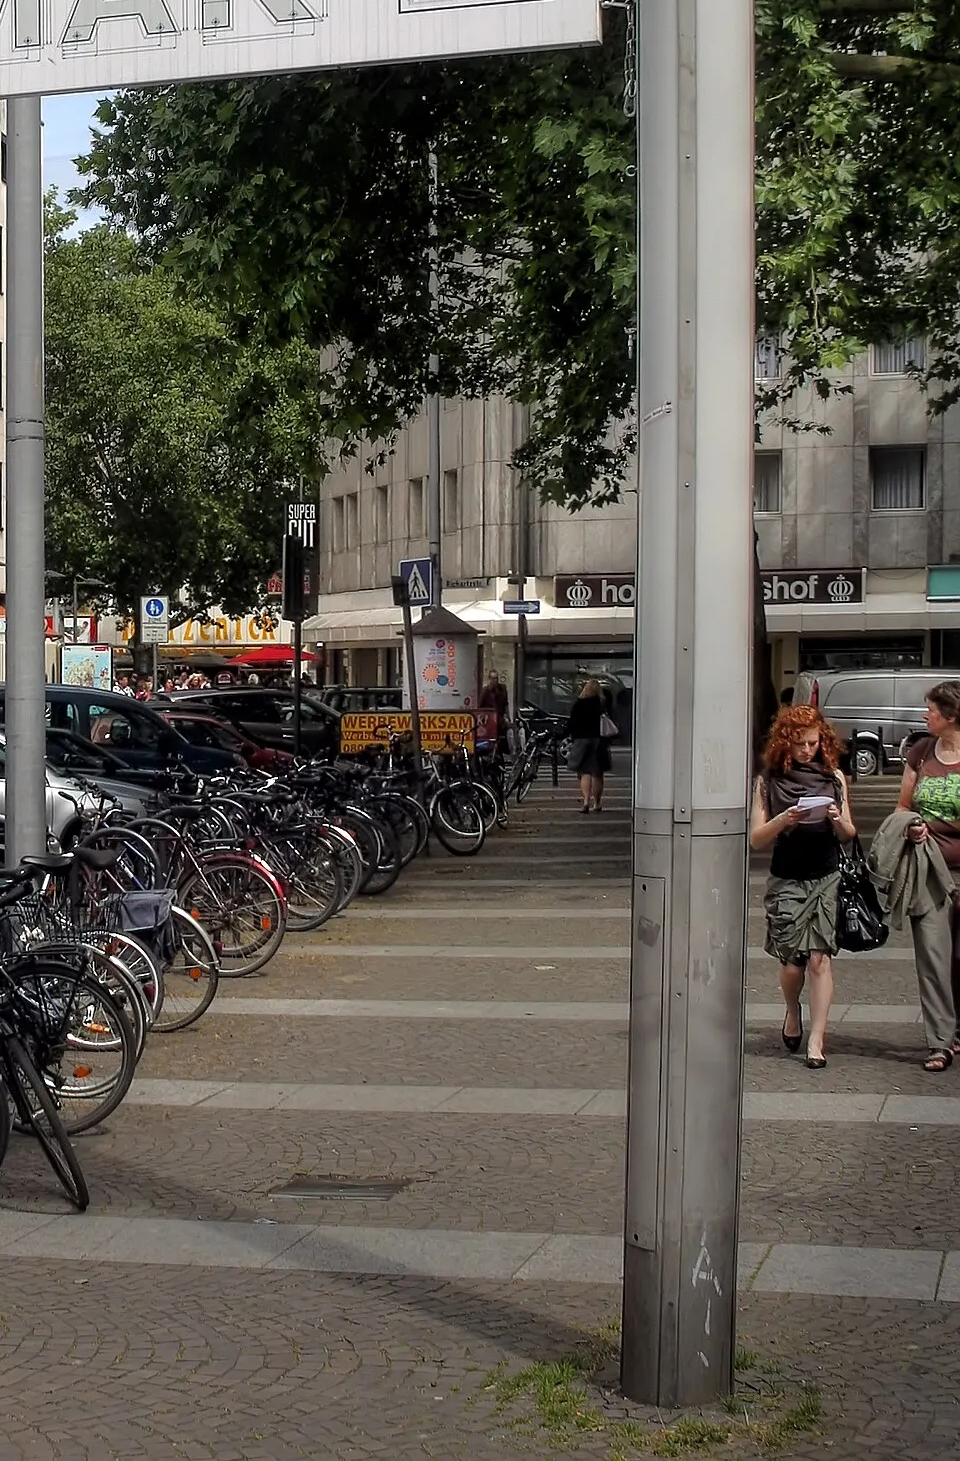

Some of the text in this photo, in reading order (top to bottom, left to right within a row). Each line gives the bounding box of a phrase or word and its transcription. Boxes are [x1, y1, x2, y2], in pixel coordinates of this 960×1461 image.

[288, 504, 316, 520] SUPER
[601, 574, 819, 604] ho shof
[343, 715, 473, 730] WERBEWRKSAM
